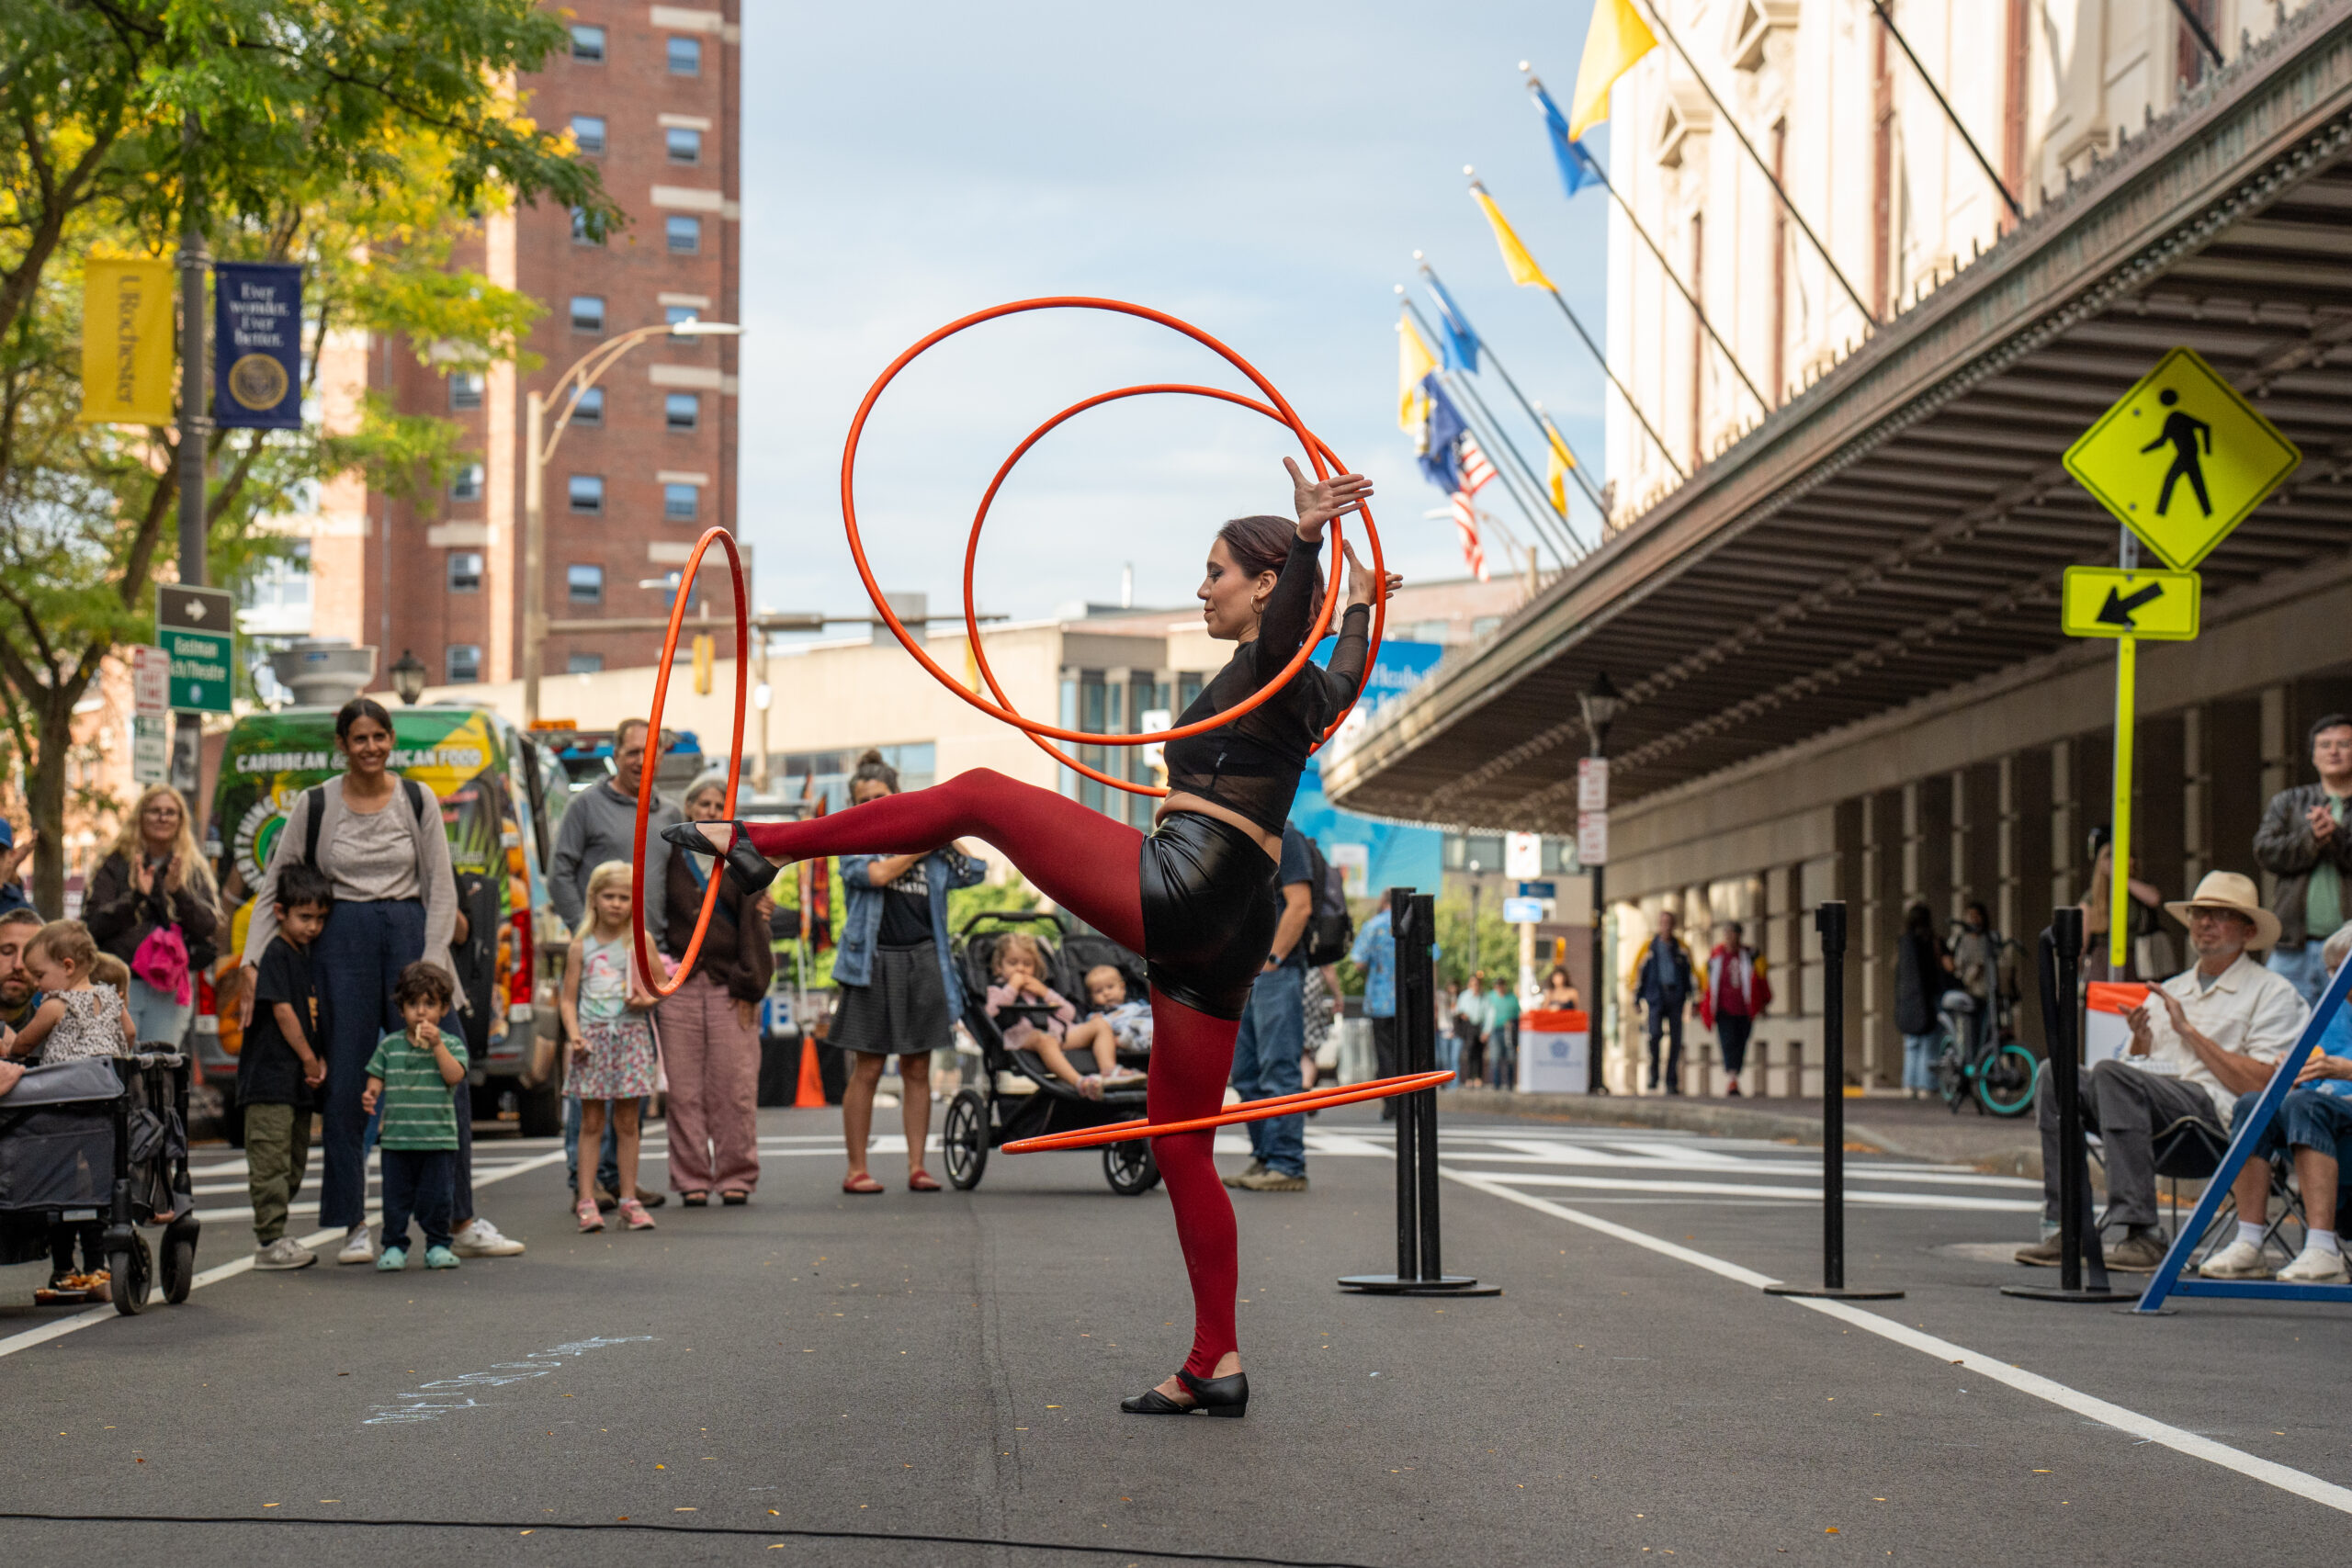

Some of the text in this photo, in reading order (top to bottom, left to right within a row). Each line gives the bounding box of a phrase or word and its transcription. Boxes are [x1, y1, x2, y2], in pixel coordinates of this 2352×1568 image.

[175, 637, 219, 658] Eastman
[236, 752, 327, 773] CARIBBEAN
[439, 750, 481, 767] FOOD
